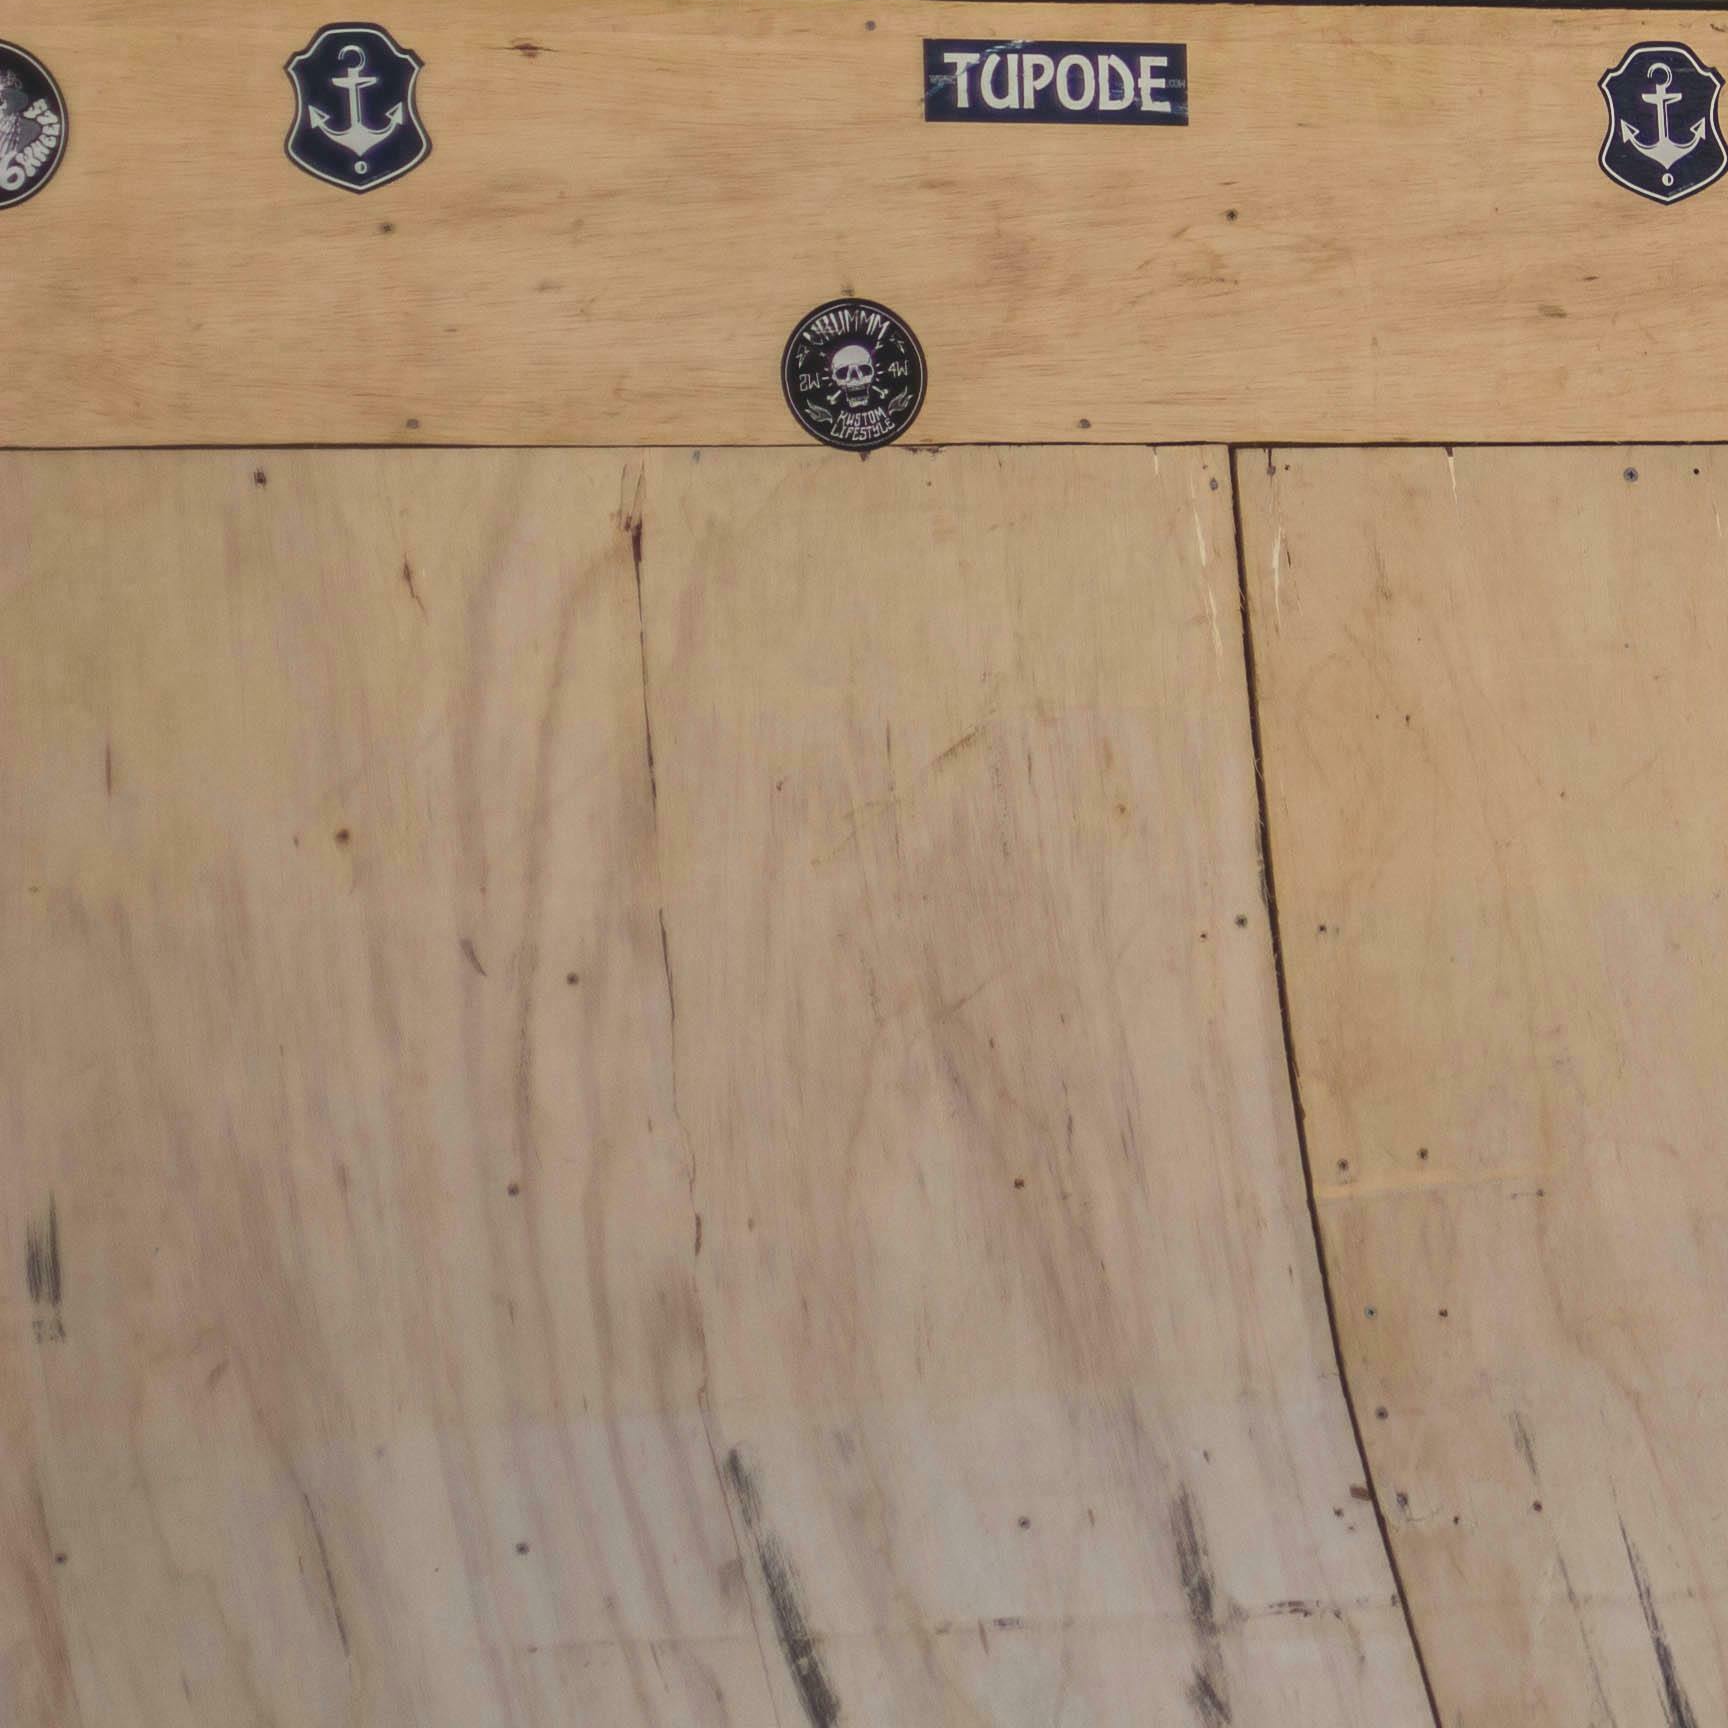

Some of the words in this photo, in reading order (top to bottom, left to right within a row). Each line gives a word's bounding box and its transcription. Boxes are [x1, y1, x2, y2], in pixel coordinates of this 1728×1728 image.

[943, 52, 1172, 113] TUPODE
[887, 359, 909, 377] 4W
[837, 406, 887, 426] KUSTOM
[830, 417, 896, 441] LIFESTYLE
